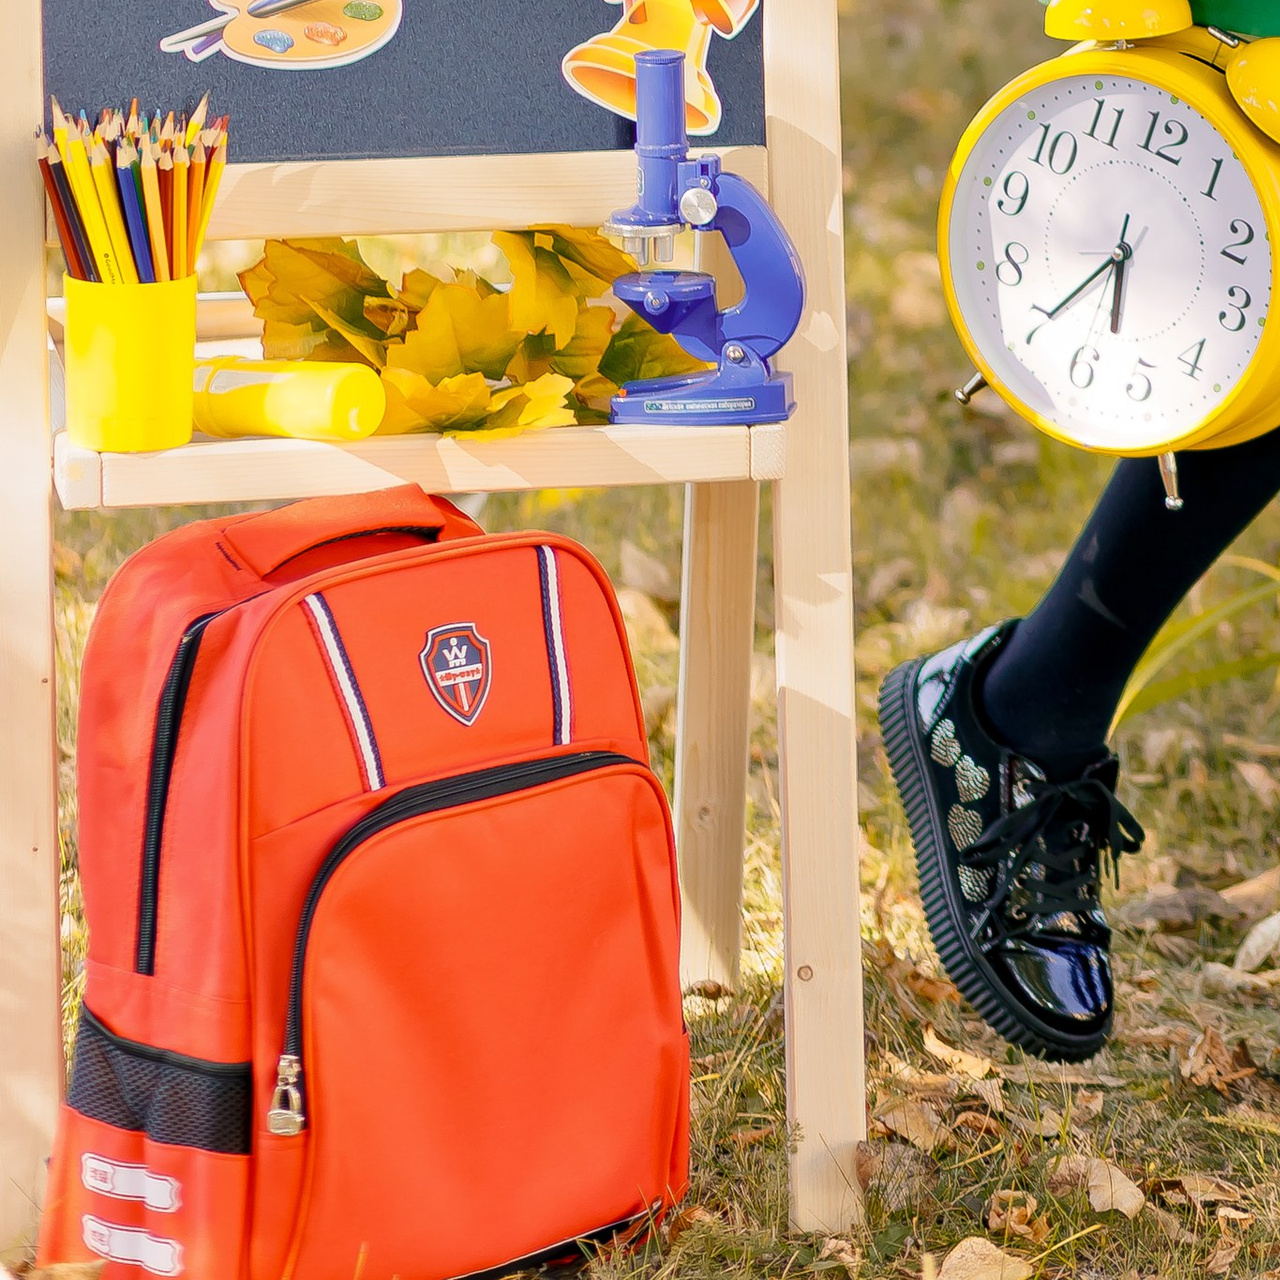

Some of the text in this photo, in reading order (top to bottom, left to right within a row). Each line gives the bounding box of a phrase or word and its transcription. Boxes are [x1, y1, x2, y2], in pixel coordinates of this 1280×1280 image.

[1082, 97, 1125, 151] 11
[1137, 110, 1190, 166] 12
[1027, 122, 1078, 176] 10
[997, 170, 1030, 216] 9
[1200, 157, 1224, 202] 1
[995, 241, 1029, 286] 8
[1219, 218, 1254, 265] 2
[1218, 285, 1252, 332] 3
[1069, 345, 1100, 389] 6
[1126, 357, 1158, 402] 5
[1177, 337, 1207, 381] 4
